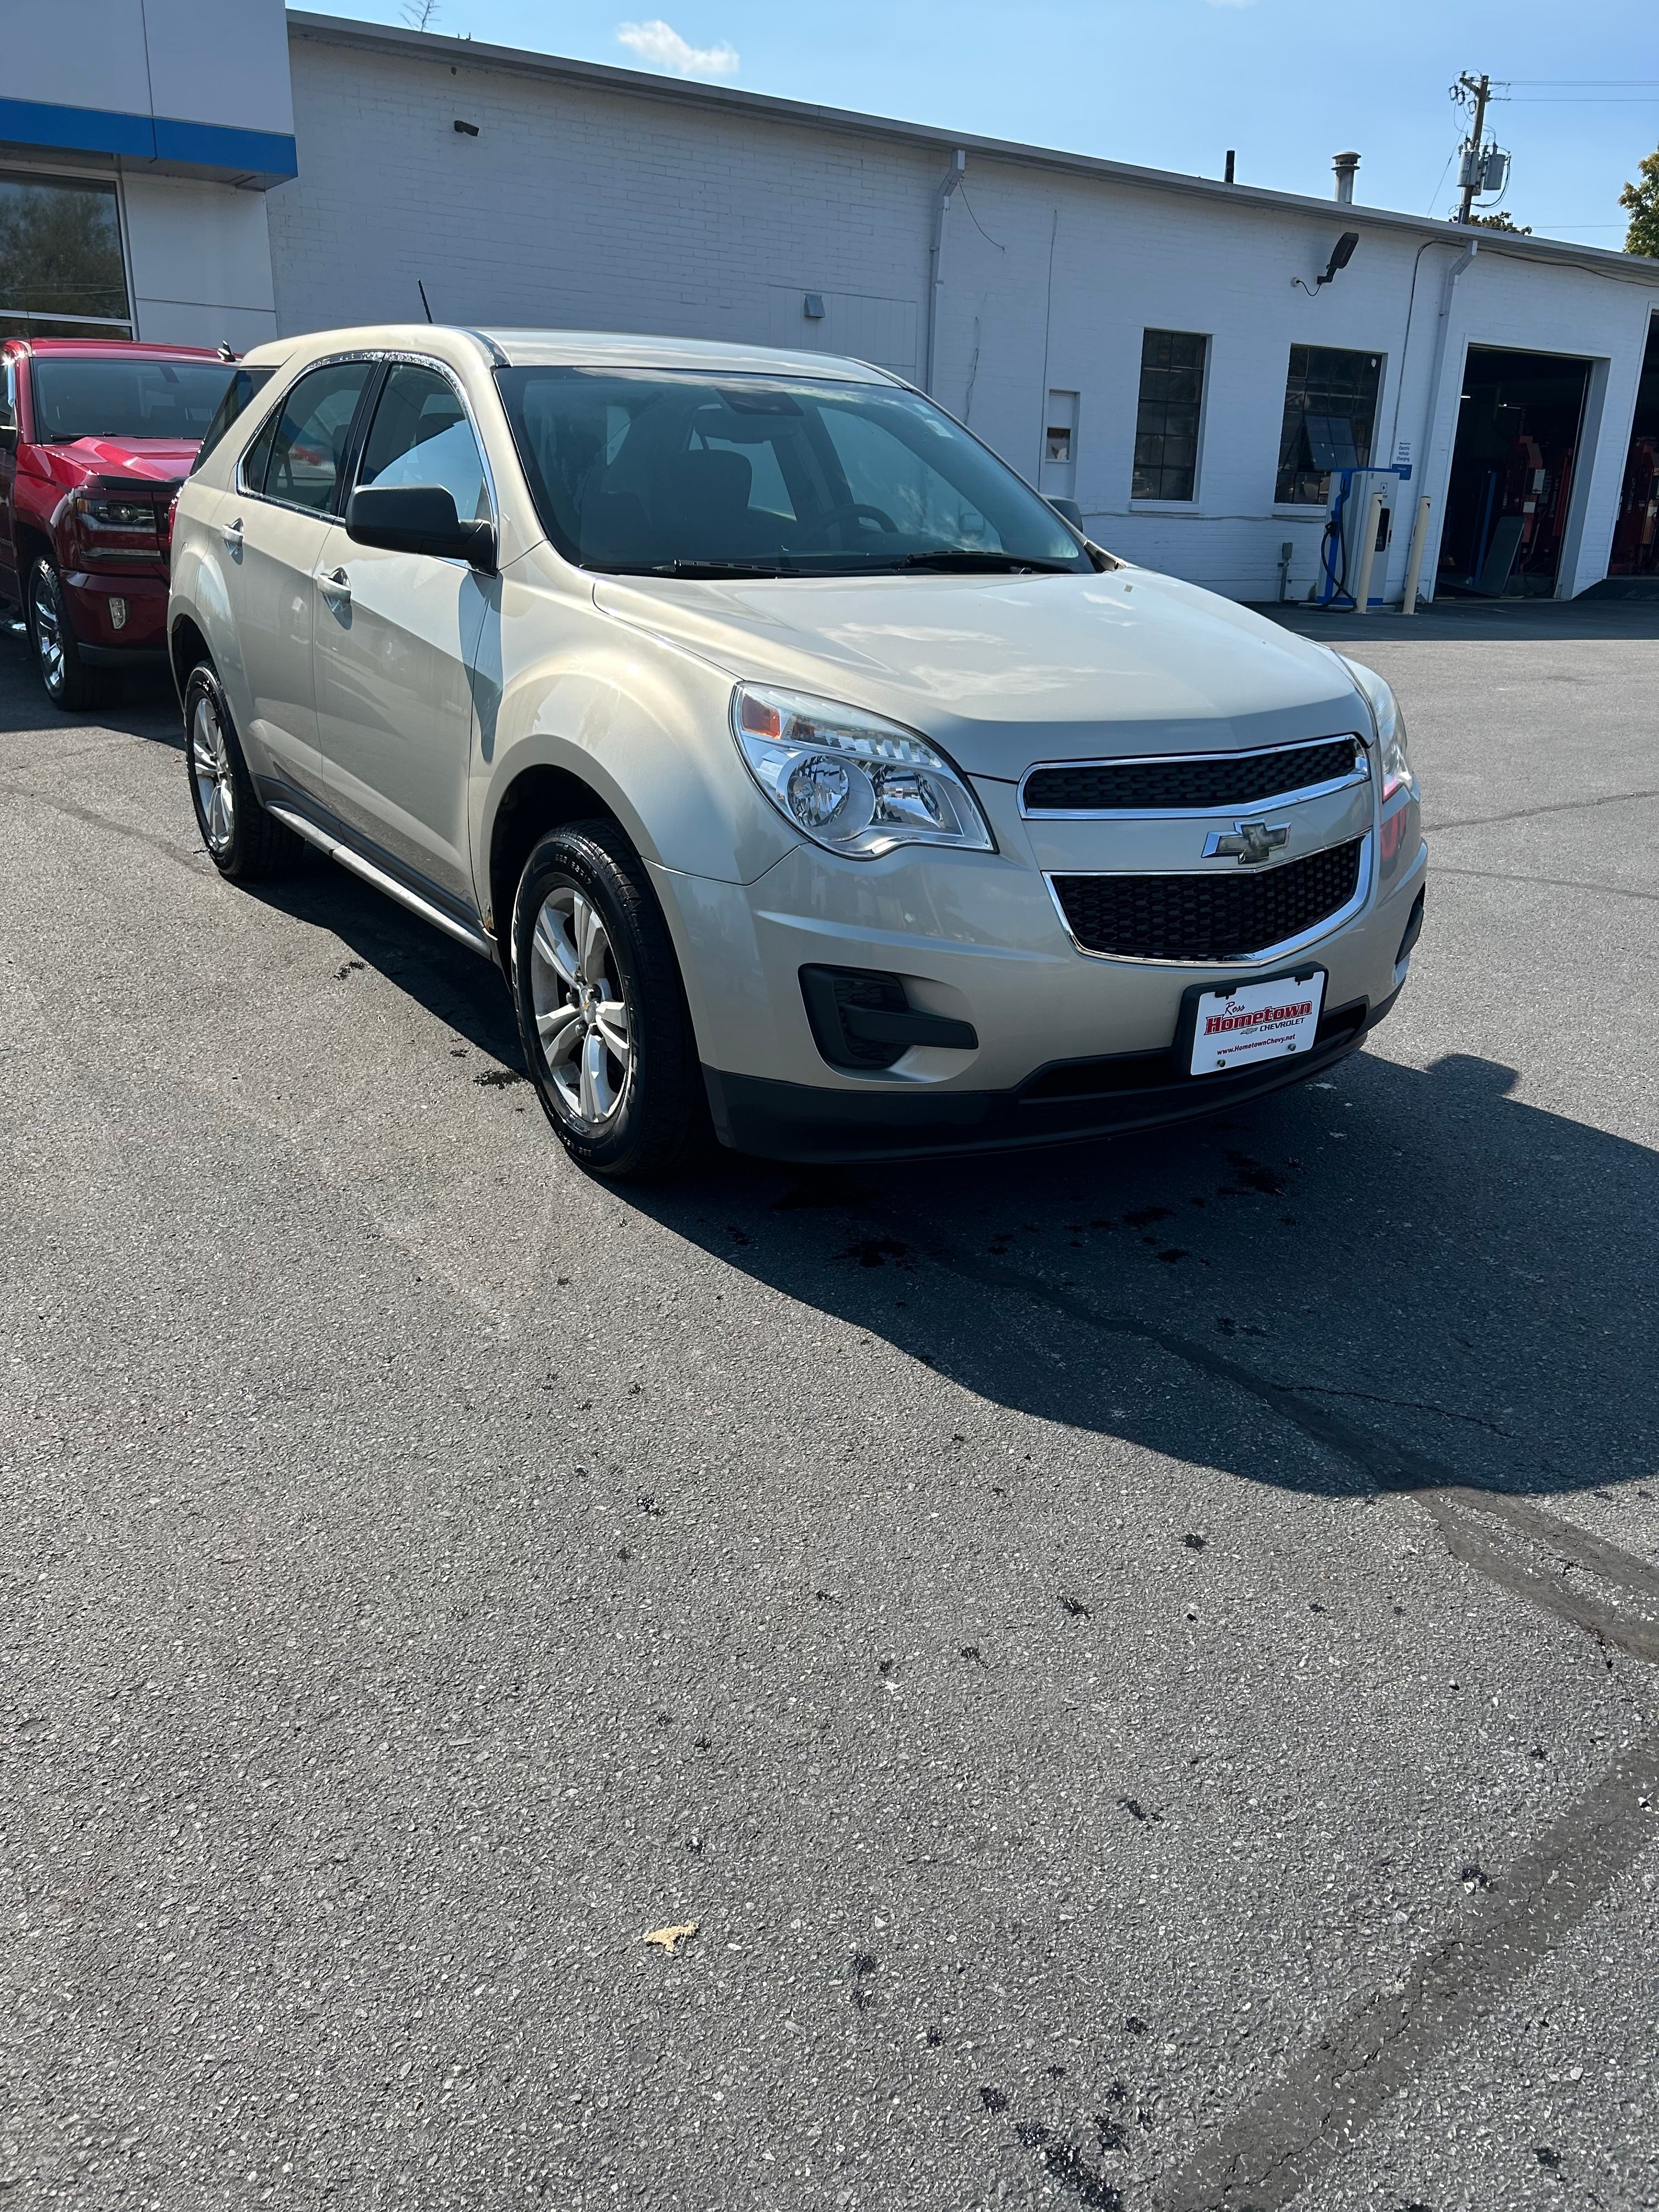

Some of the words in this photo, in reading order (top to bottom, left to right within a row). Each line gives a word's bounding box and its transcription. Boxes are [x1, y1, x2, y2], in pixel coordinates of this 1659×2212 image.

[1224, 1001, 1245, 1015] Ross
[1204, 1001, 1312, 1035] Hometown
[1260, 1017, 1305, 1032] CHEVROLET
[1217, 1034, 1295, 1056] www.HometownChevy.net
